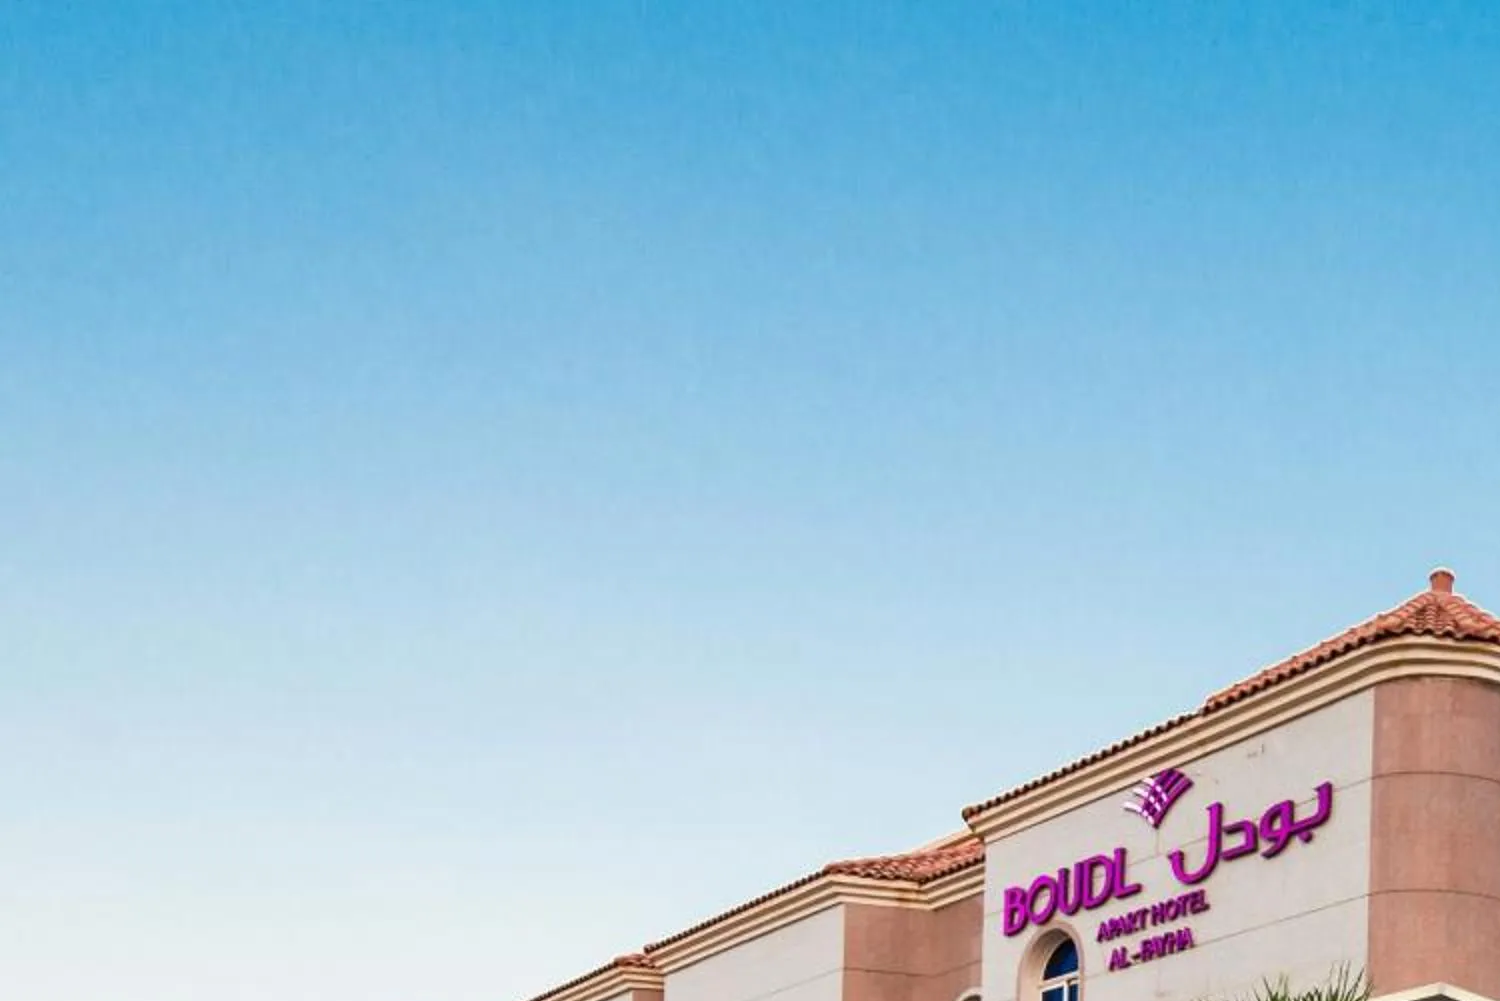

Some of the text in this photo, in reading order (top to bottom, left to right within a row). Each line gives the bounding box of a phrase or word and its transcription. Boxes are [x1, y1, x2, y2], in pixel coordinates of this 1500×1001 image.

[1168, 780, 1334, 885] بودل
[1002, 846, 1142, 937] BOUDL
[1096, 889, 1210, 943] APART HOTEL
